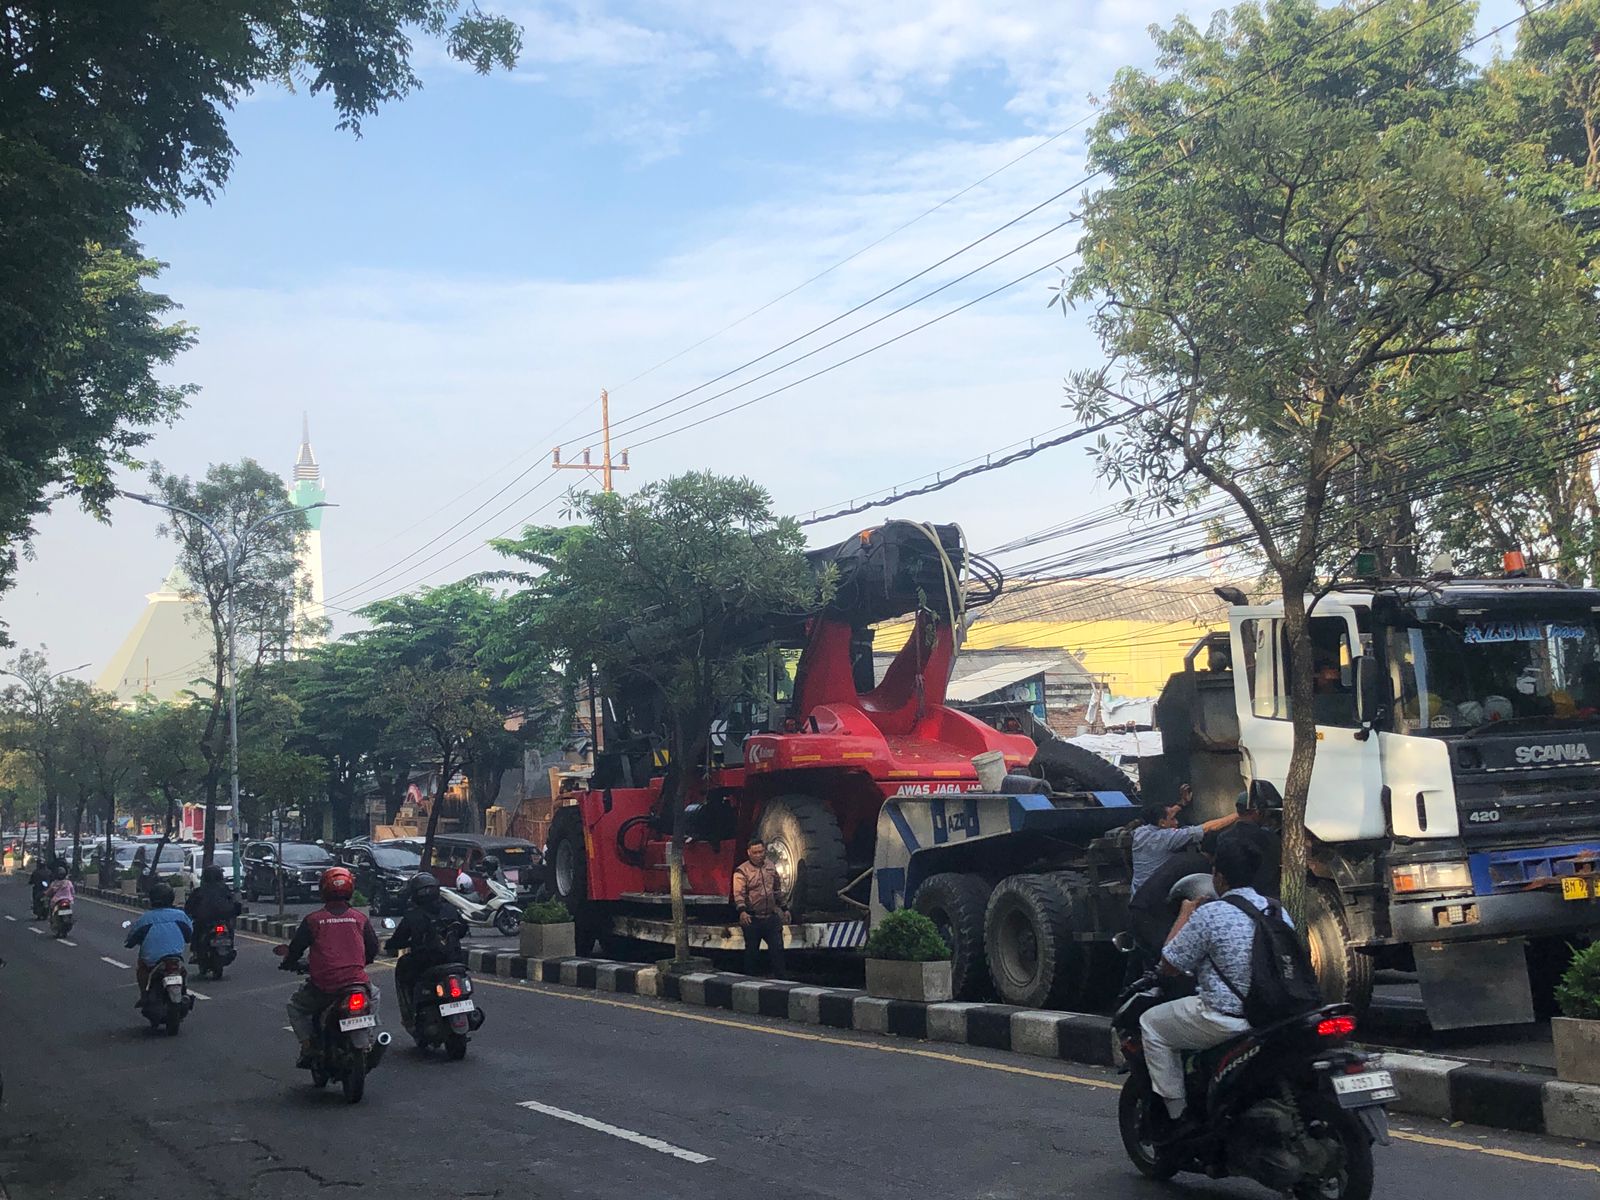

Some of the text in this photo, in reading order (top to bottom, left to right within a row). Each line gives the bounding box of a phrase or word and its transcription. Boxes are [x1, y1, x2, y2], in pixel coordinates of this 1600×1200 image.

[1515, 743, 1590, 763] SCANIA
[897, 784, 931, 796] AWAS
[933, 784, 961, 795] JAGA
[1469, 810, 1500, 822] 420
